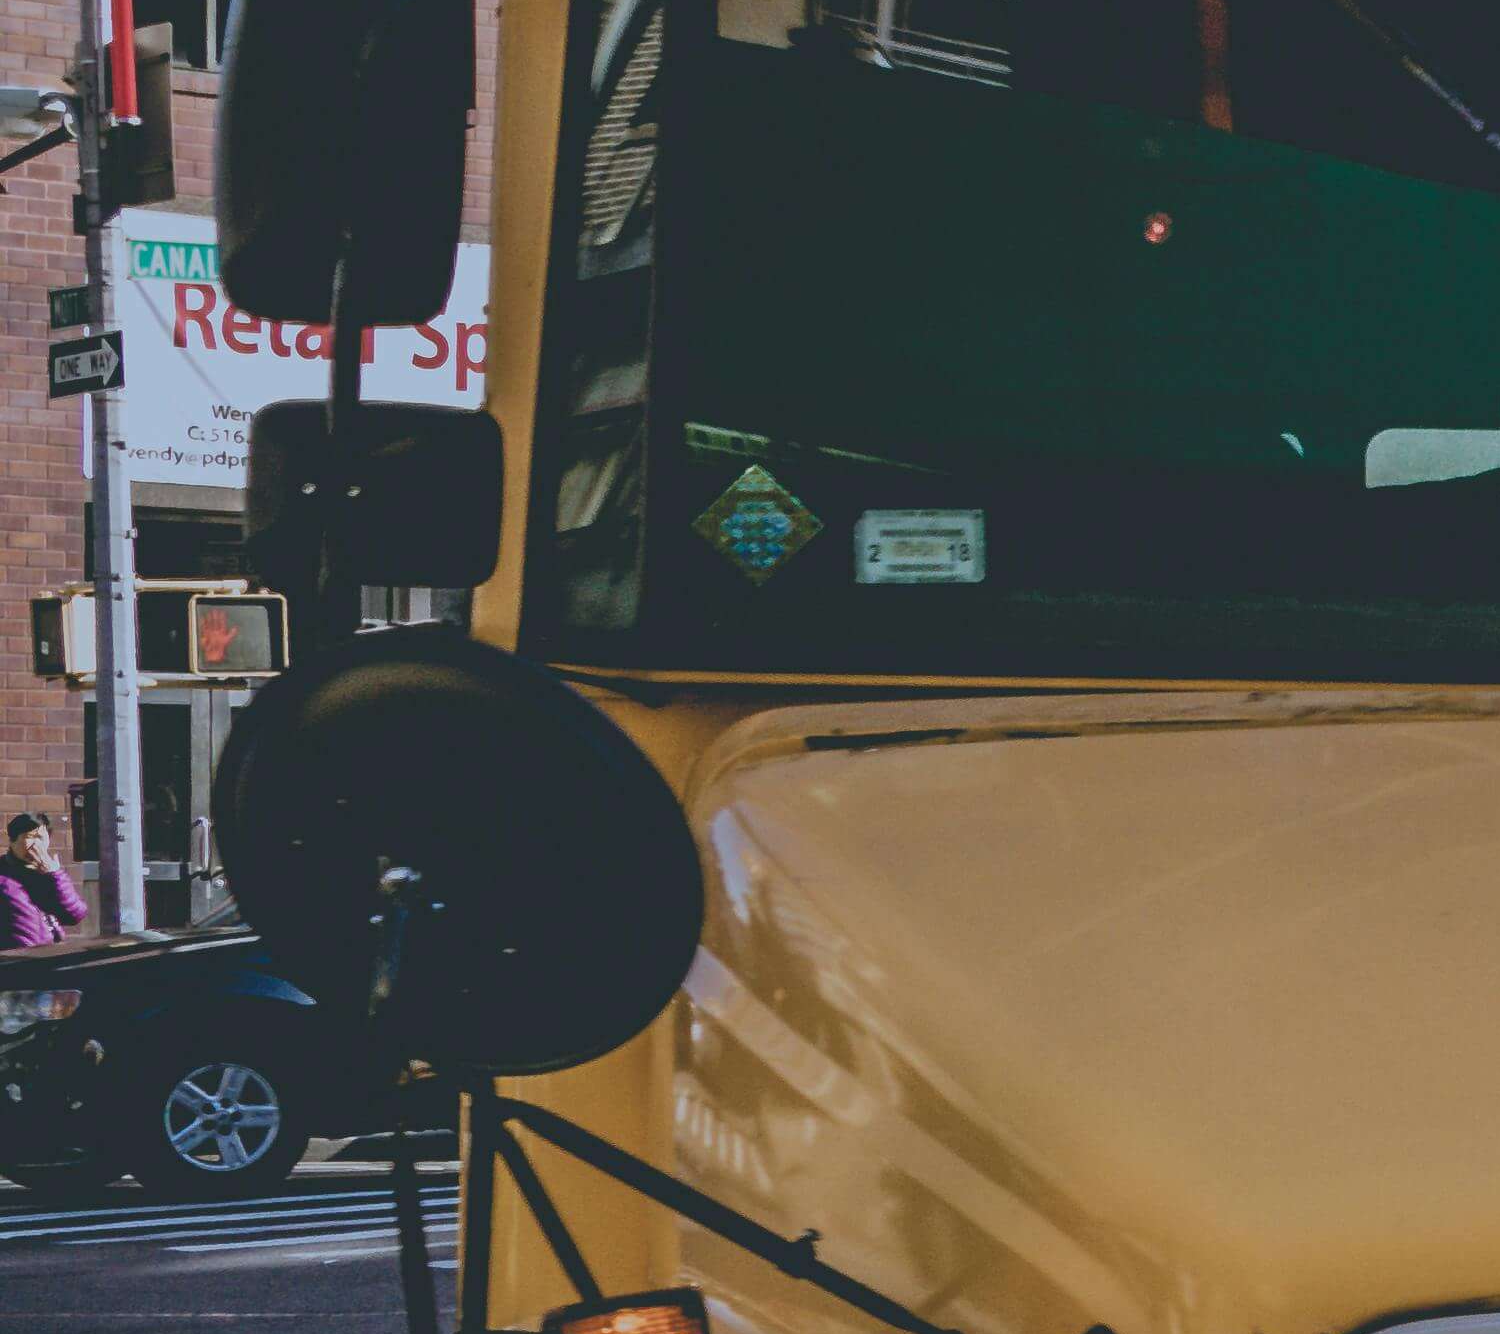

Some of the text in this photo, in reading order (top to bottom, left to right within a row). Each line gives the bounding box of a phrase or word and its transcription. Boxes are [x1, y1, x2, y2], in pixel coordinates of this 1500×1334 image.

[133, 242, 220, 278] CANAL
[59, 351, 113, 381] ONE WAY
